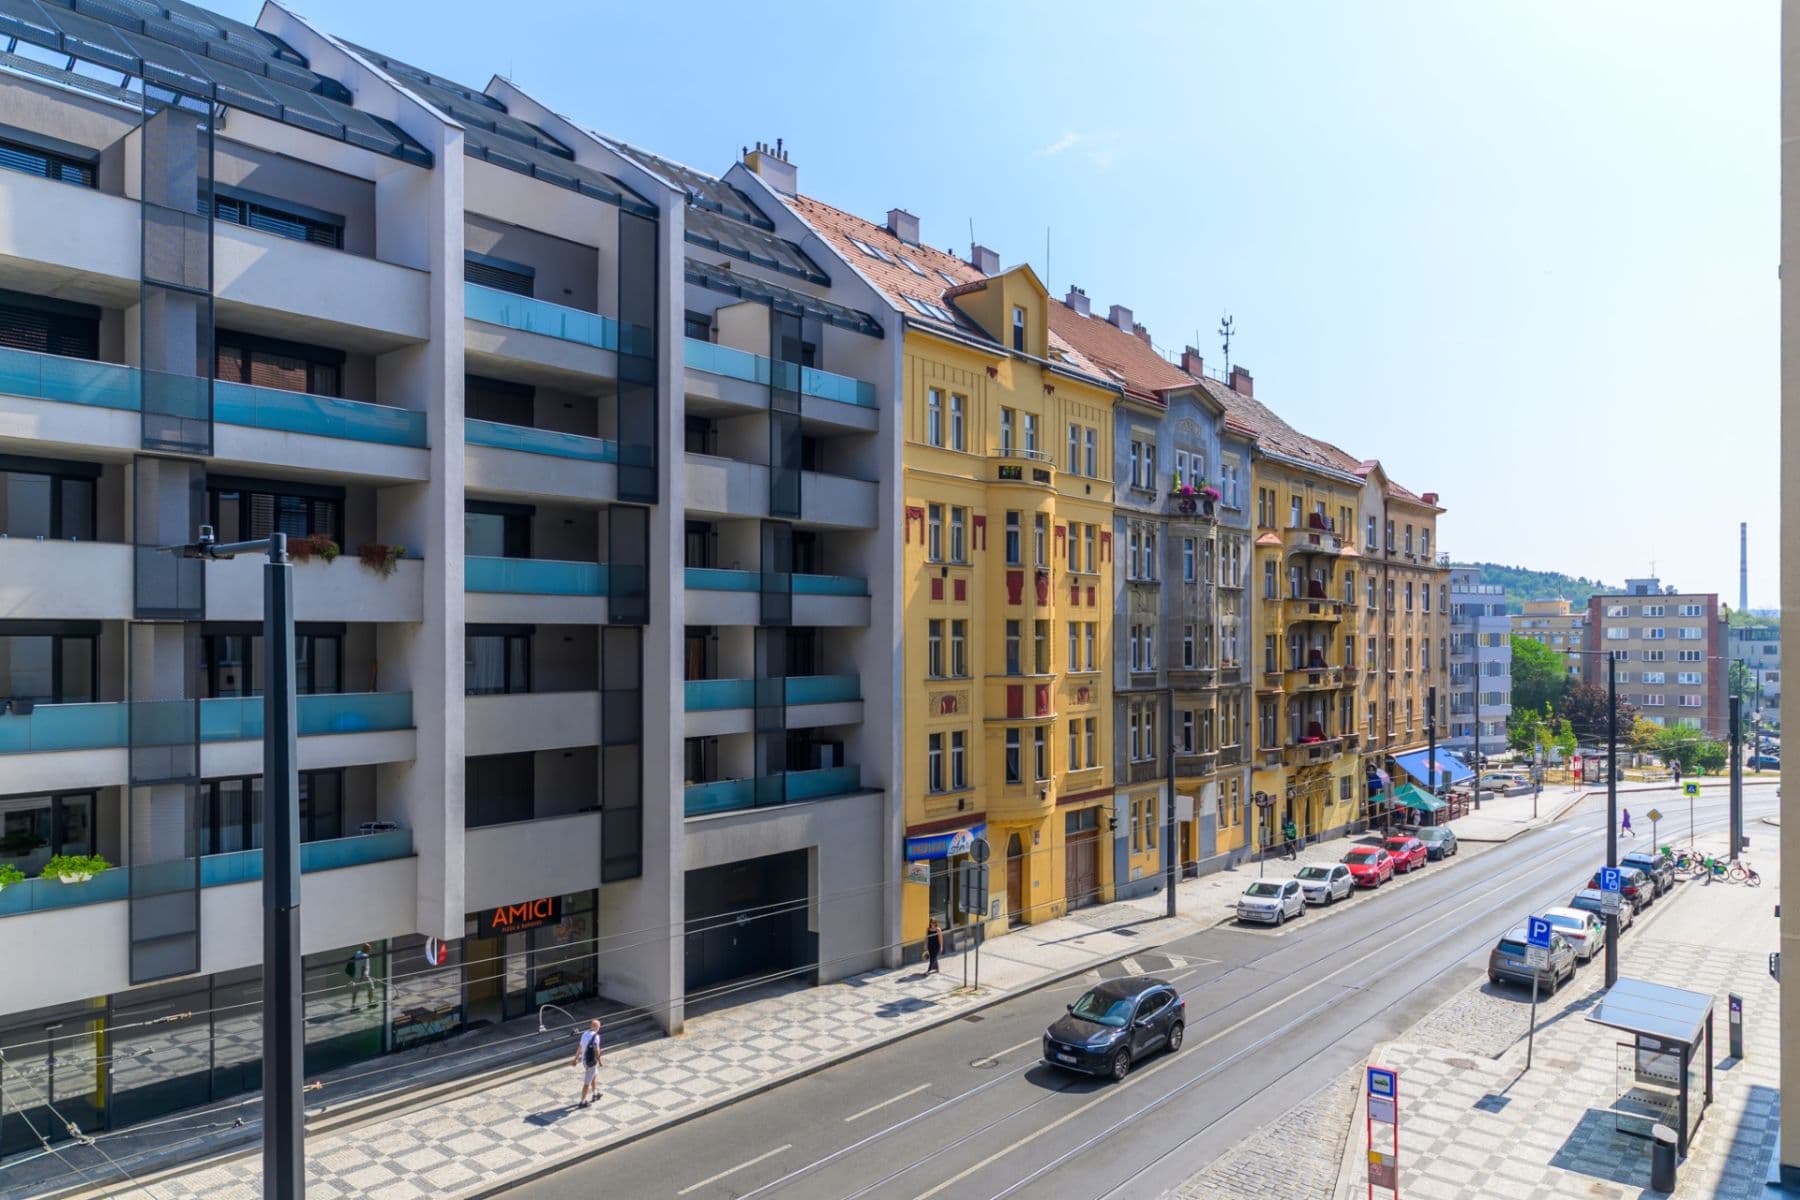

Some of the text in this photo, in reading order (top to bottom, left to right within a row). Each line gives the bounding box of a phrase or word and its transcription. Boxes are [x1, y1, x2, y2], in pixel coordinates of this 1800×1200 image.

[1605, 870, 1617, 885] P
[491, 896, 553, 928] AMICI
[1533, 921, 1548, 938] P
